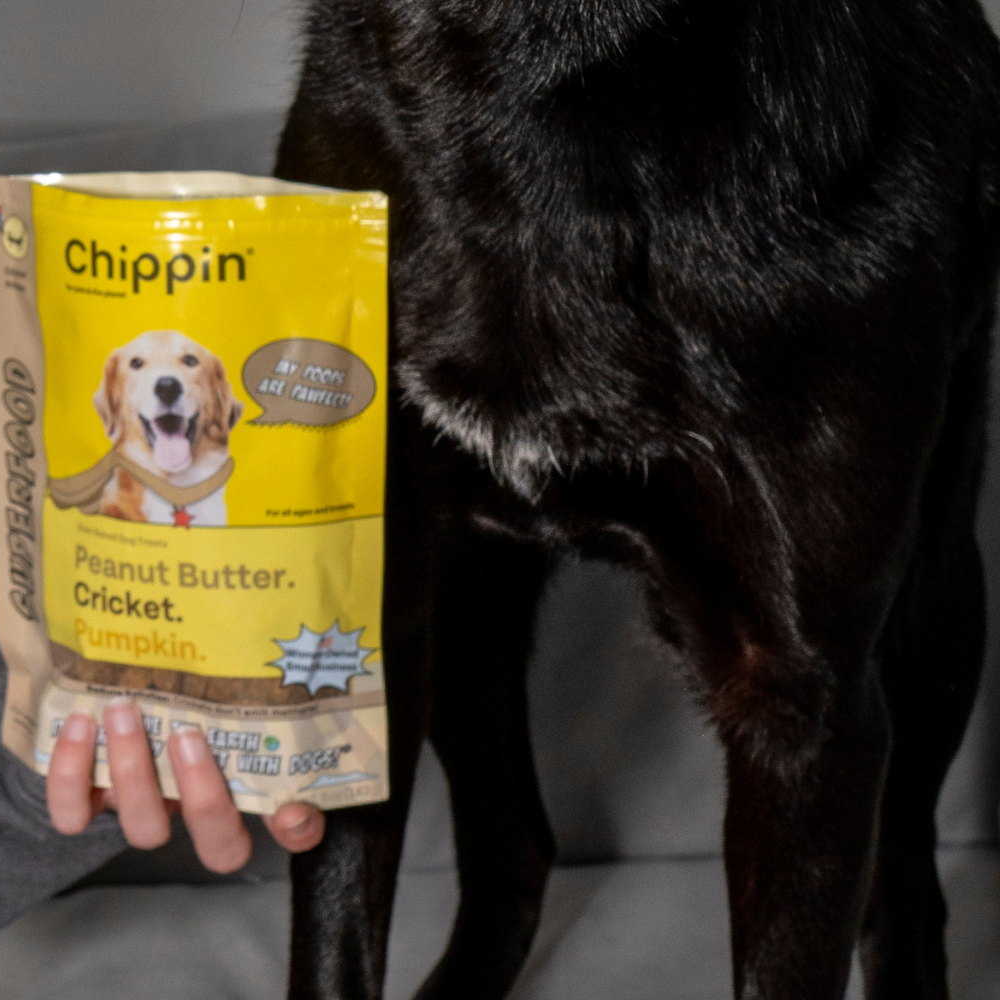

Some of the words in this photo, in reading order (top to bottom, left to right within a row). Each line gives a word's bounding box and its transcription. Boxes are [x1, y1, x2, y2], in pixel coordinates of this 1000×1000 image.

[256, 377, 287, 397] ARE
[74, 545, 170, 587] Peanut
[178, 561, 296, 590] Butter.
[74, 581, 184, 623] Cricket.
[74, 616, 206, 662] Pumpkin.
[206, 727, 261, 753] EARTH
[236, 754, 282, 776] WITH
